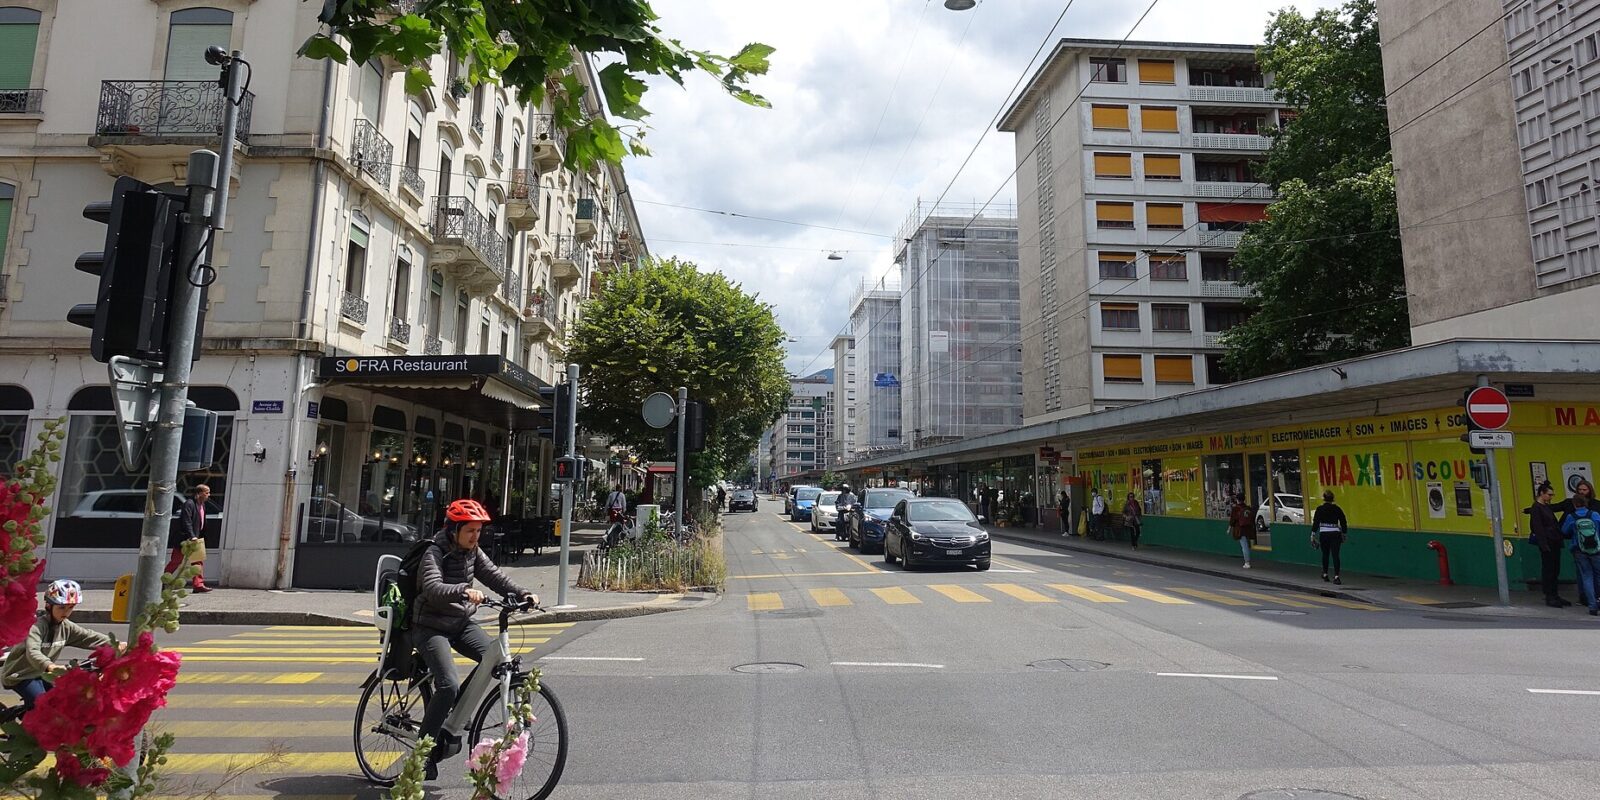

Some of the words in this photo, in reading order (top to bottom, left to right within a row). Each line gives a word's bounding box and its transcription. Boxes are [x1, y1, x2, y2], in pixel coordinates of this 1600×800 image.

[335, 359, 390, 373] SOFRA
[393, 359, 468, 372] Restaurant
[1356, 423, 1374, 436] SON
[1390, 418, 1428, 433] IMAGES
[1447, 414, 1467, 428] SO
[1209, 434, 1233, 450] MAXI
[1318, 452, 1382, 487] MAXI
